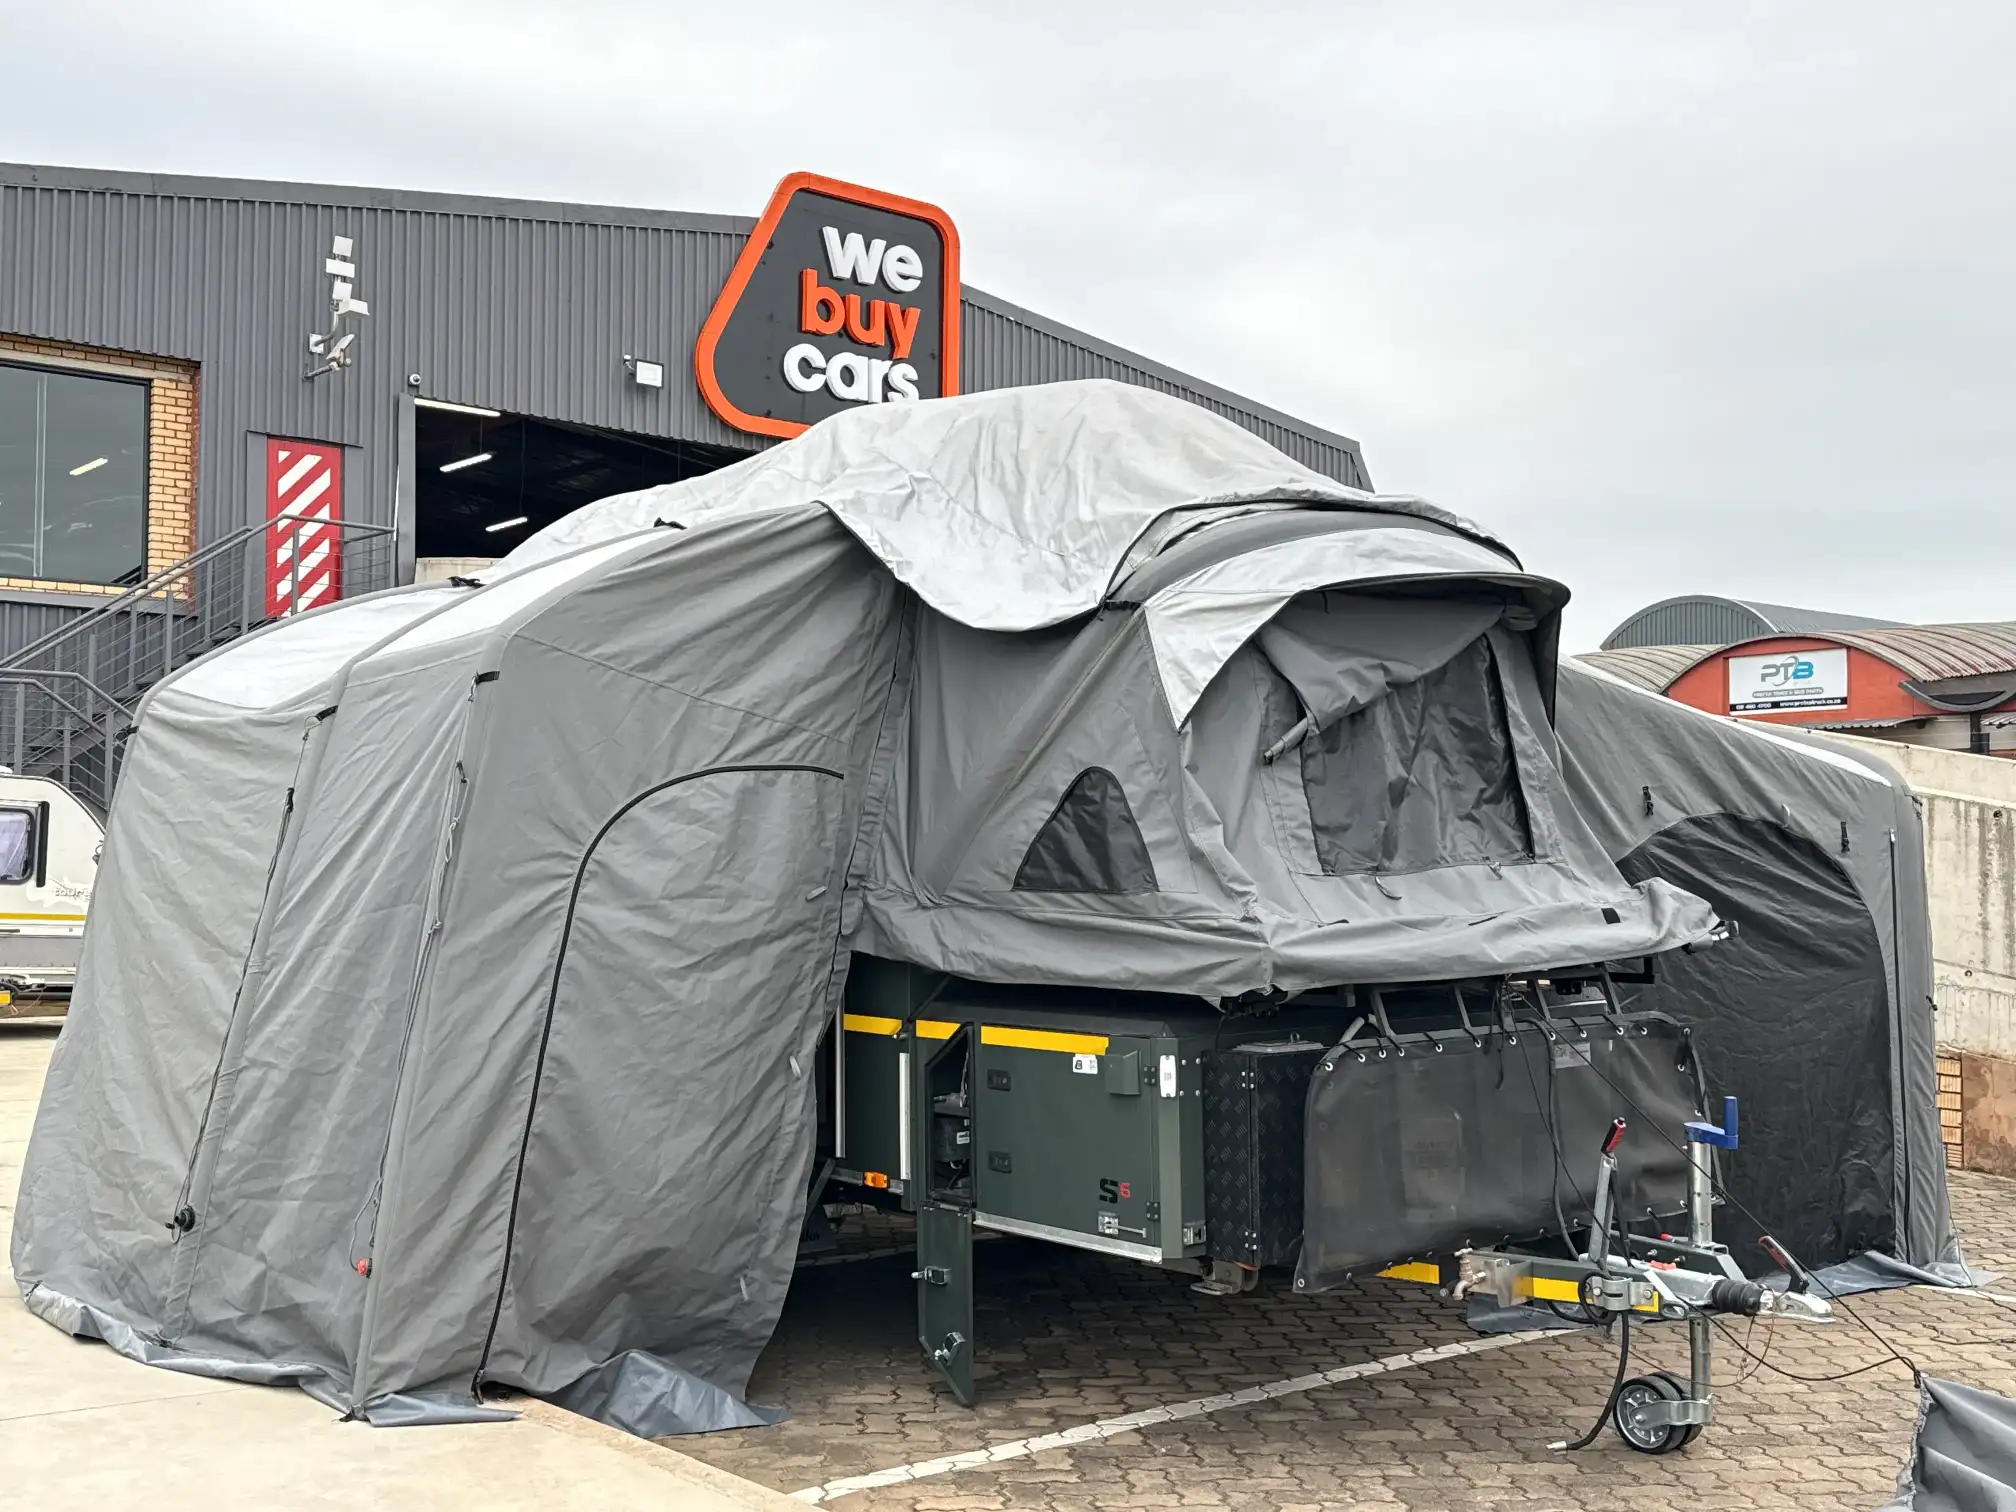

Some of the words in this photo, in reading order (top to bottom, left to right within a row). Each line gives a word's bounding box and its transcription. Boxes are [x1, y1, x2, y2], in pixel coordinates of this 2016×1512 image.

[822, 225, 924, 293] we
[801, 267, 922, 360] buy
[783, 342, 920, 404] cars
[1760, 660, 1814, 683] PTB
